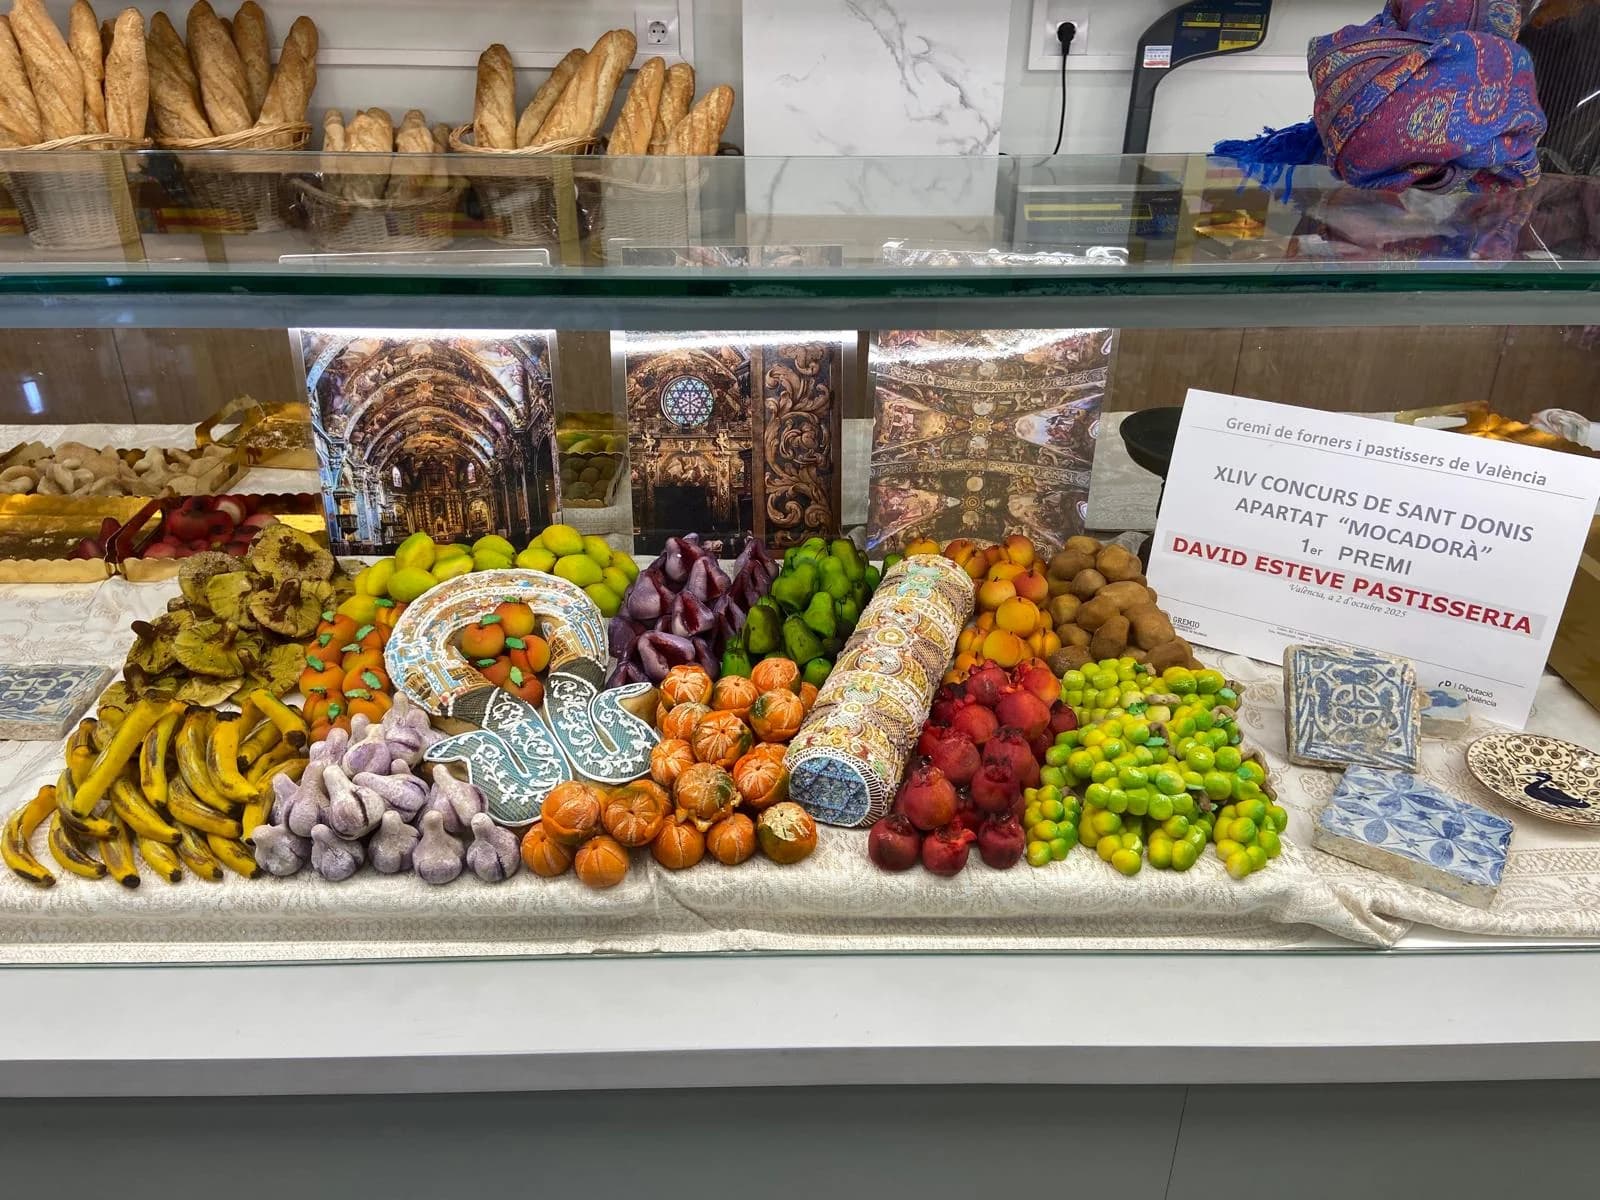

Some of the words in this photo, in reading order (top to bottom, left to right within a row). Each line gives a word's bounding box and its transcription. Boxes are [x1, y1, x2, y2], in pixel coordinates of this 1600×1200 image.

[1226, 417, 1270, 435] Gremi
[1274, 425, 1293, 439] de
[1297, 429, 1352, 449] forners
[1356, 439, 1361, 452] i
[1364, 444, 1444, 468] pastissers
[1449, 457, 1470, 471] de
[1475, 460, 1546, 486] València
[1213, 466, 1257, 486] XLIV
[1261, 475, 1358, 507] CONCURS
[1363, 495, 1392, 514] DE
[1396, 502, 1457, 526] SANT
[1460, 514, 1534, 542] DONIS
[1234, 497, 1328, 528] APARTAT
[1339, 517, 1492, 561] “MOCADORÀ”
[1302, 538, 1323, 557] 1er
[1338, 546, 1412, 575] PREMI
[1172, 537, 1247, 566] DAVID
[1254, 556, 1346, 590] ESTEVE
[1351, 577, 1531, 635] PASTISSERIA
[1336, 595, 1342, 603] 2
[1384, 607, 1407, 618] 2025
[1173, 616, 1200, 628] GREMIO
[1458, 684, 1493, 698] Diputació
